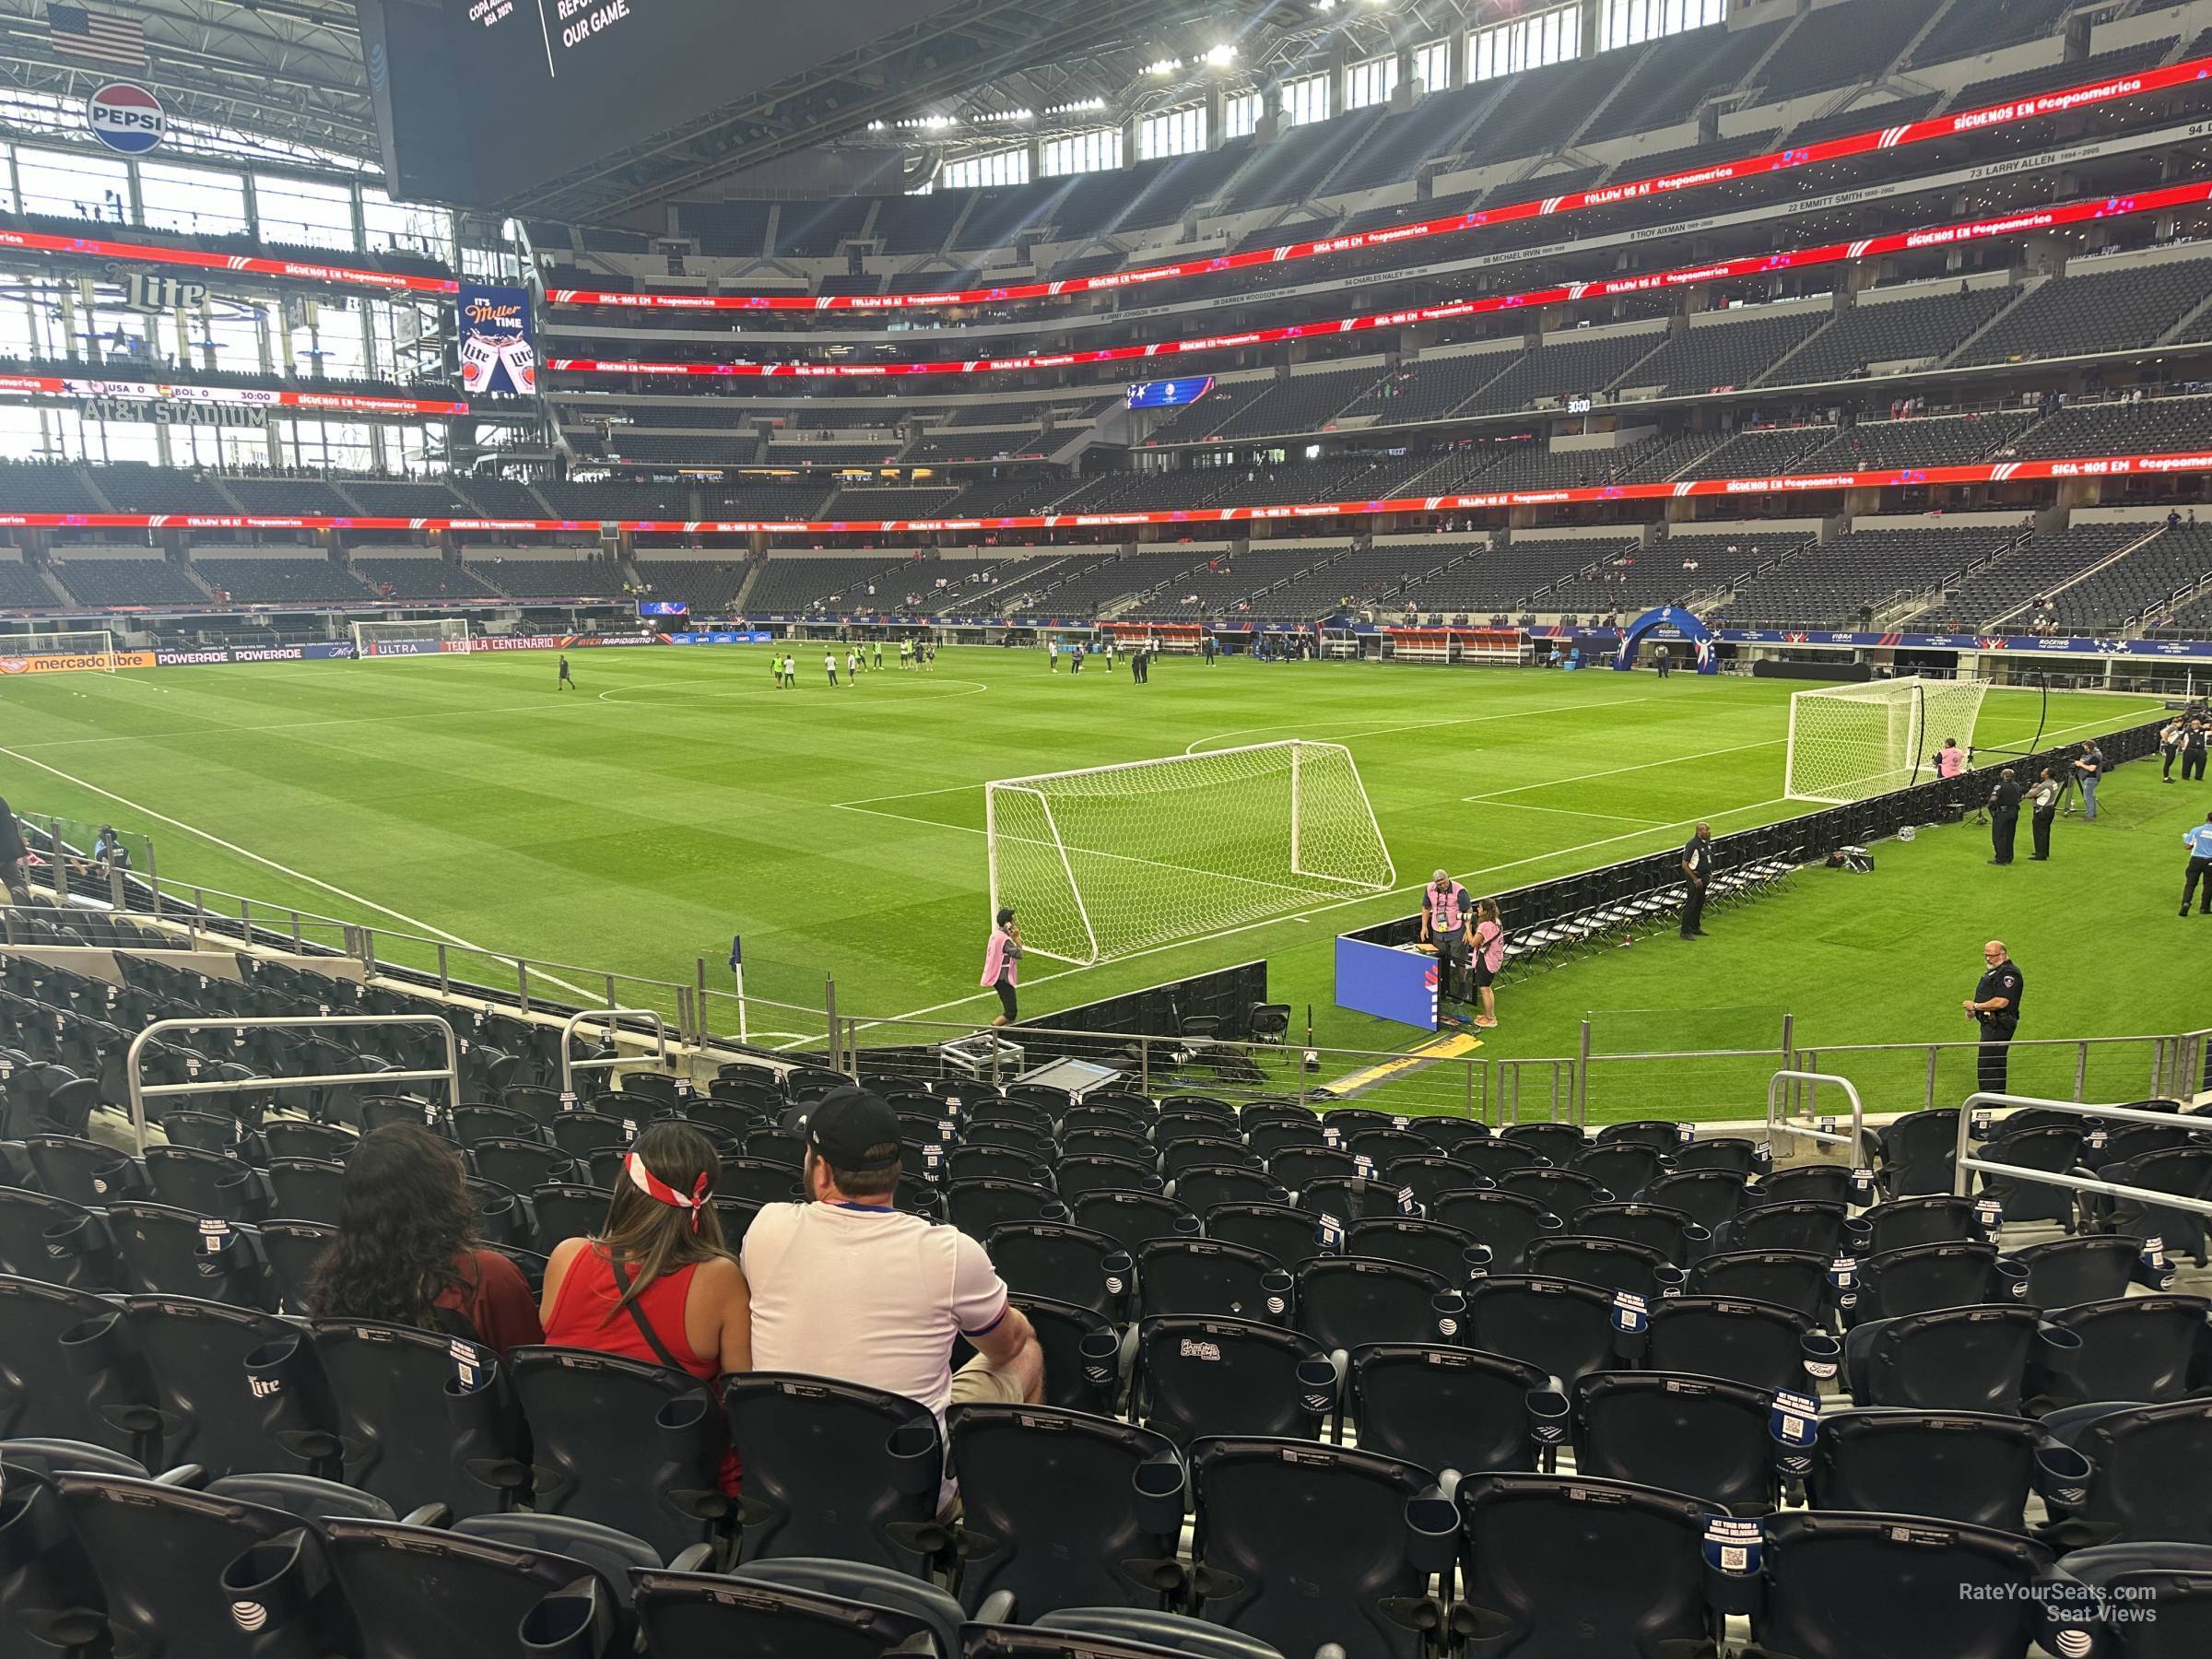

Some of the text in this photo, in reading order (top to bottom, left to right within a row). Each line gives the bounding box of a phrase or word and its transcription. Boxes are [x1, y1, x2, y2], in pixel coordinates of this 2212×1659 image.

[484, 13, 498, 27] USA
[563, 3, 630, 47] OUR GAME.
[2017, 102, 2035, 116] EN
[93, 107, 161, 131] PEPSI
[2188, 124, 2203, 135] 94
[1970, 154, 2055, 178] 73 LARRY ALLEN
[1584, 191, 1621, 204] FOLLOW
[1624, 186, 1637, 196] US
[1638, 183, 1651, 194] AT
[1788, 204, 1797, 212] 22
[1799, 197, 1833, 210] EMMITT
[1835, 192, 1863, 204] SMITH
[1637, 229, 1656, 239] TROY
[1656, 224, 1686, 235] AIKMAN
[1957, 227, 1971, 237] EN
[1492, 253, 1521, 264] MICHAEL
[1523, 249, 1540, 258] IRVIN
[1353, 275, 1382, 285] CHARLES
[1382, 271, 1403, 280] HALEY
[124, 273, 206, 313] Lite
[1606, 281, 1638, 292] FOLLOW
[475, 298, 490, 307] IT'S
[1220, 294, 1244, 305] DARREN
[1245, 291, 1277, 301] WOODSON
[465, 305, 521, 324] Miller
[1124, 309, 1148, 318] JOHNSON
[494, 318, 524, 328] TIME
[464, 344, 489, 362] Lite
[509, 349, 533, 367] Lite
[108, 384, 130, 394] USA
[175, 388, 195, 397] BOL
[241, 392, 271, 401] 30:00
[1568, 400, 1590, 413] 30:00
[83, 399, 269, 429] AT&T STADIUM
[2112, 462, 2129, 471] EM
[379, 644, 418, 654] ULTRA
[446, 641, 488, 652] TEQUILA
[492, 638, 558, 651] CENTENARIO
[158, 653, 229, 665] POWERADE
[235, 649, 302, 661] POWERADE
[34, 655, 143, 670] mercado libre
[1182, 1340, 1217, 1351] MARKING
[1809, 1364, 1833, 1375] Ford
[248, 1375, 280, 1398] Lite
